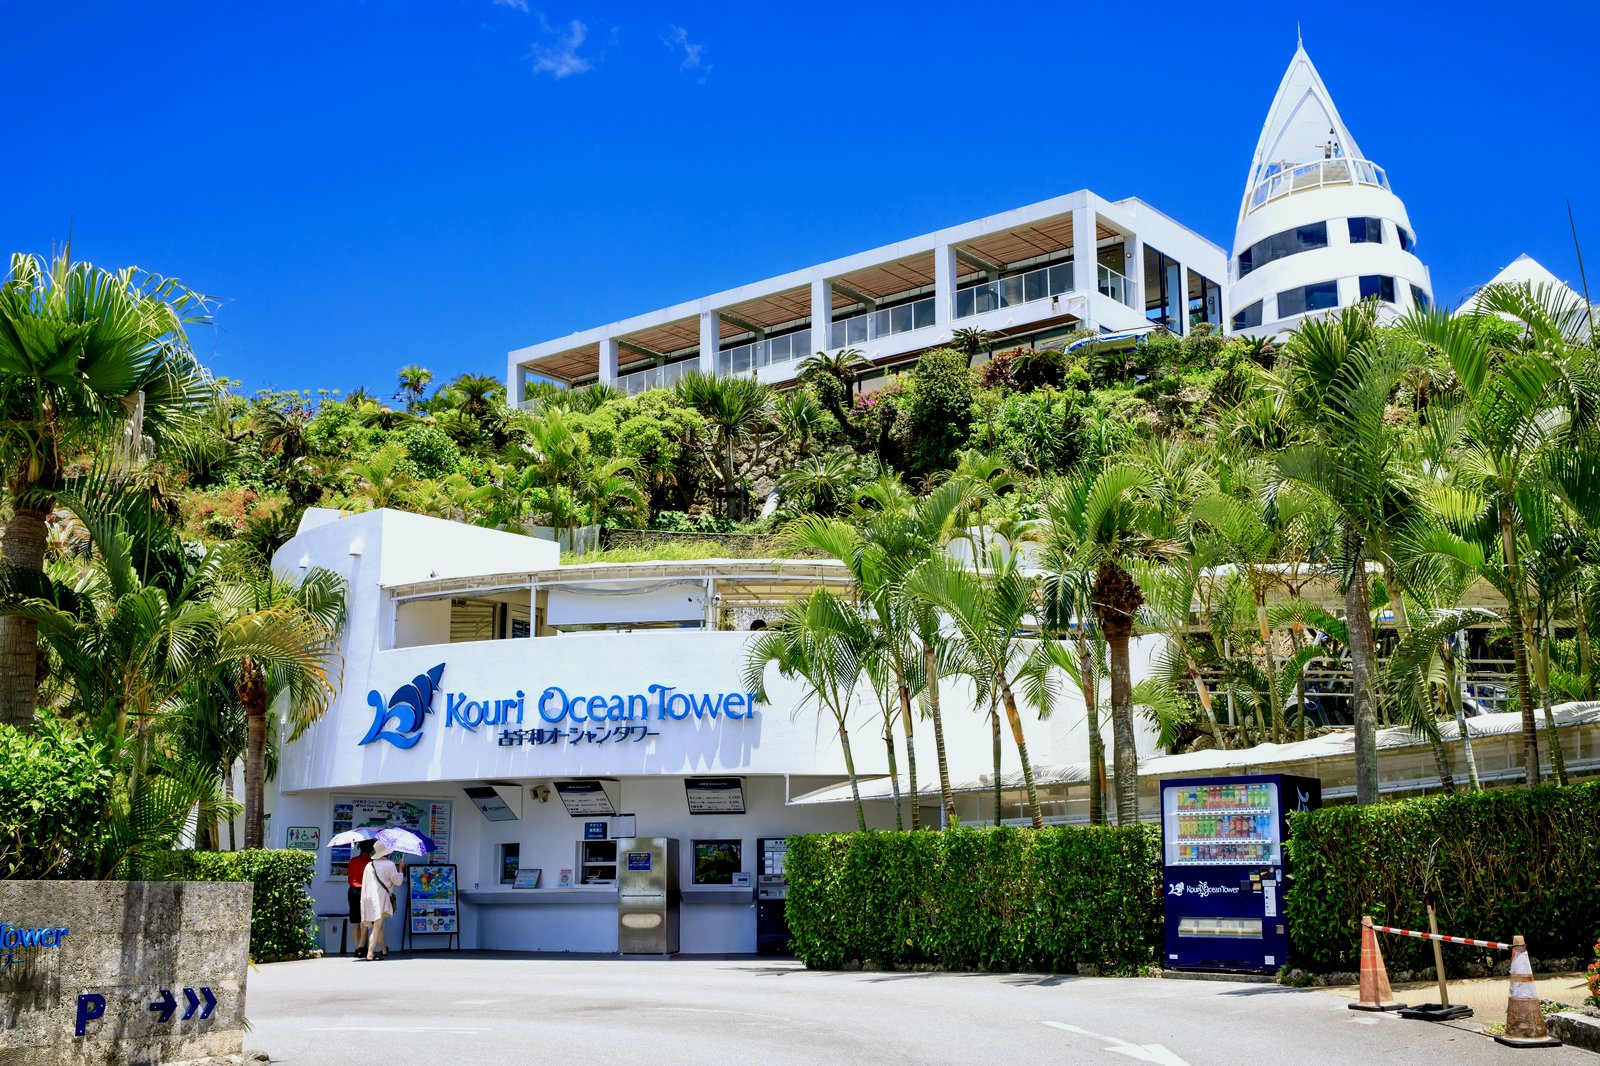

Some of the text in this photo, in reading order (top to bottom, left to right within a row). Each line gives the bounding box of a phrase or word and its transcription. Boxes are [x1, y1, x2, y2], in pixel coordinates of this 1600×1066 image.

[445, 684, 760, 733] Kouri Ocean Tower
[498, 726, 660, 747] 古宇利オーシャンタワー
[1220, 885, 1240, 894] Tower
[75, 993, 107, 1037] P
